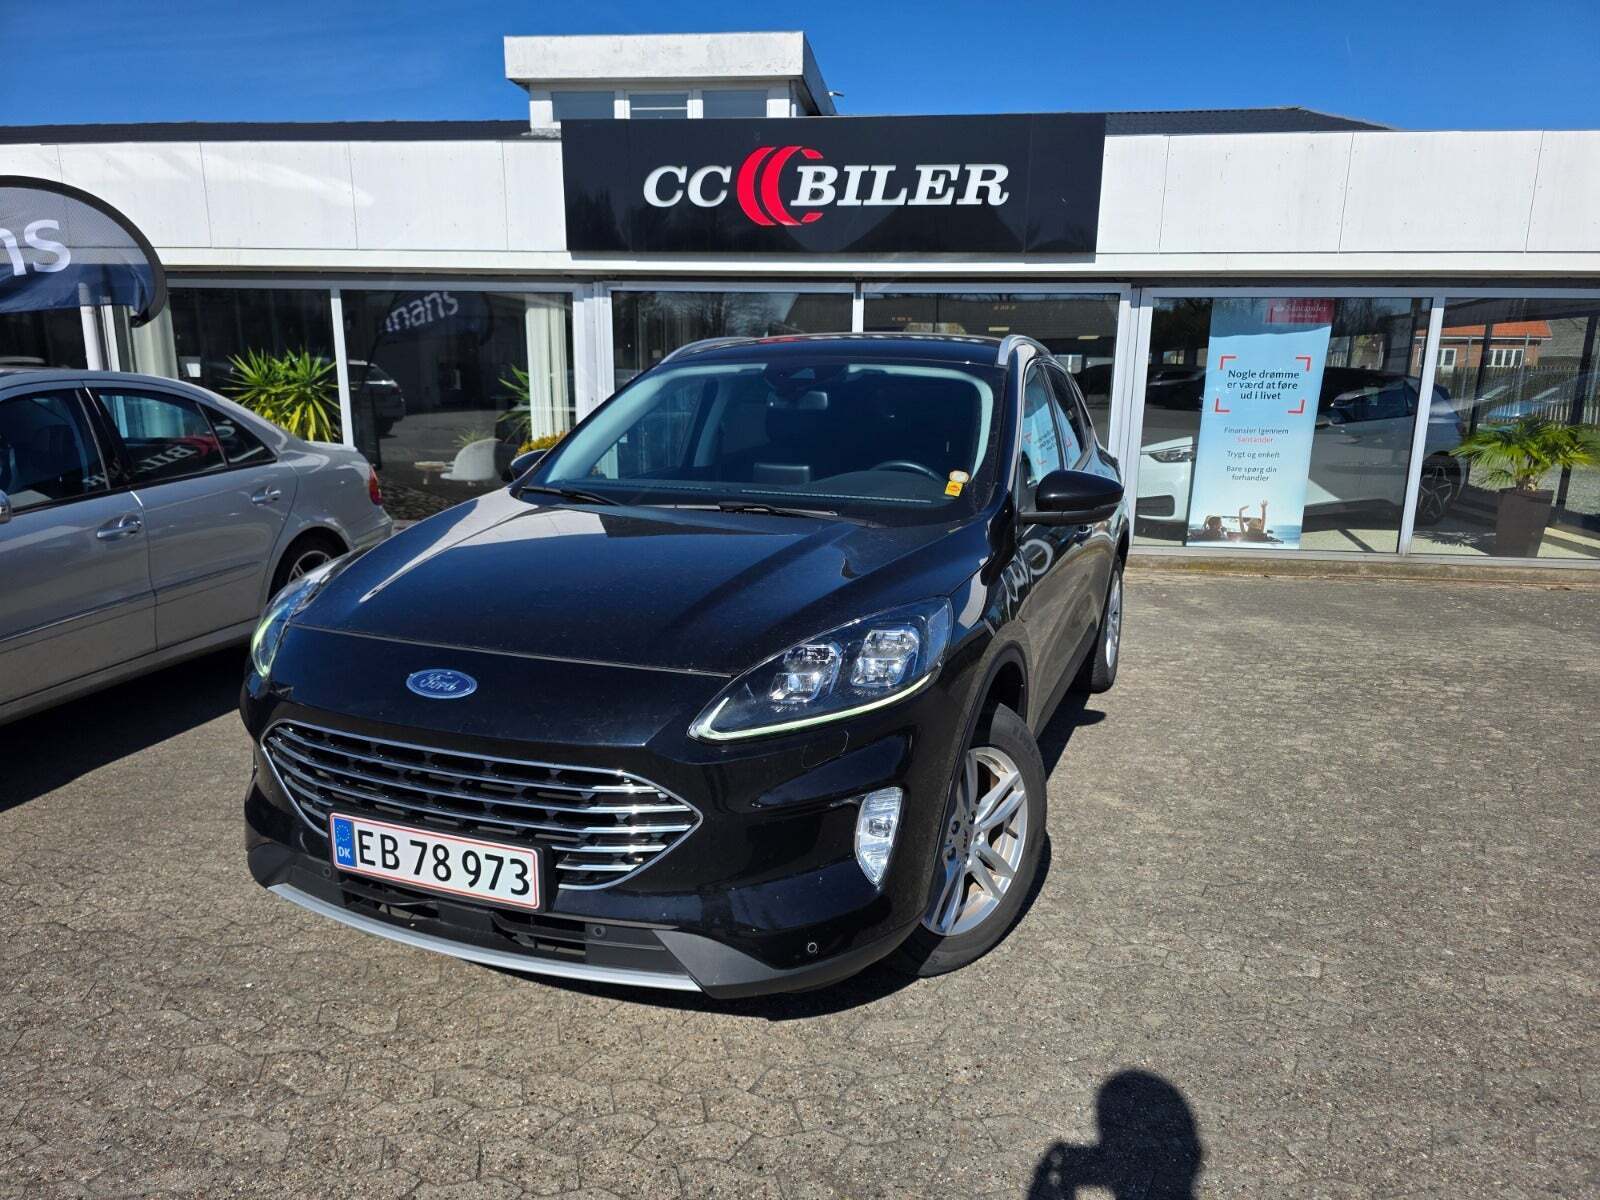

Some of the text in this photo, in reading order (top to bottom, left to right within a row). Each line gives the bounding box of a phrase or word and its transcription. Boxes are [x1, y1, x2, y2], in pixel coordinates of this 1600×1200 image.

[643, 163, 1009, 207] CC BILER
[1228, 369, 1300, 380] Nogle drømme
[1226, 380, 1298, 390] er værd at føre
[1240, 391, 1281, 400] ud i livet
[1224, 426, 1257, 434] Finansier
[1227, 450, 1246, 458] Trygt
[1226, 465, 1243, 473] Bare
[1244, 467, 1264, 475] spørg
[1231, 474, 1269, 482] forhandler
[338, 845, 351, 859] DK
[357, 829, 530, 896] EB 78 973
